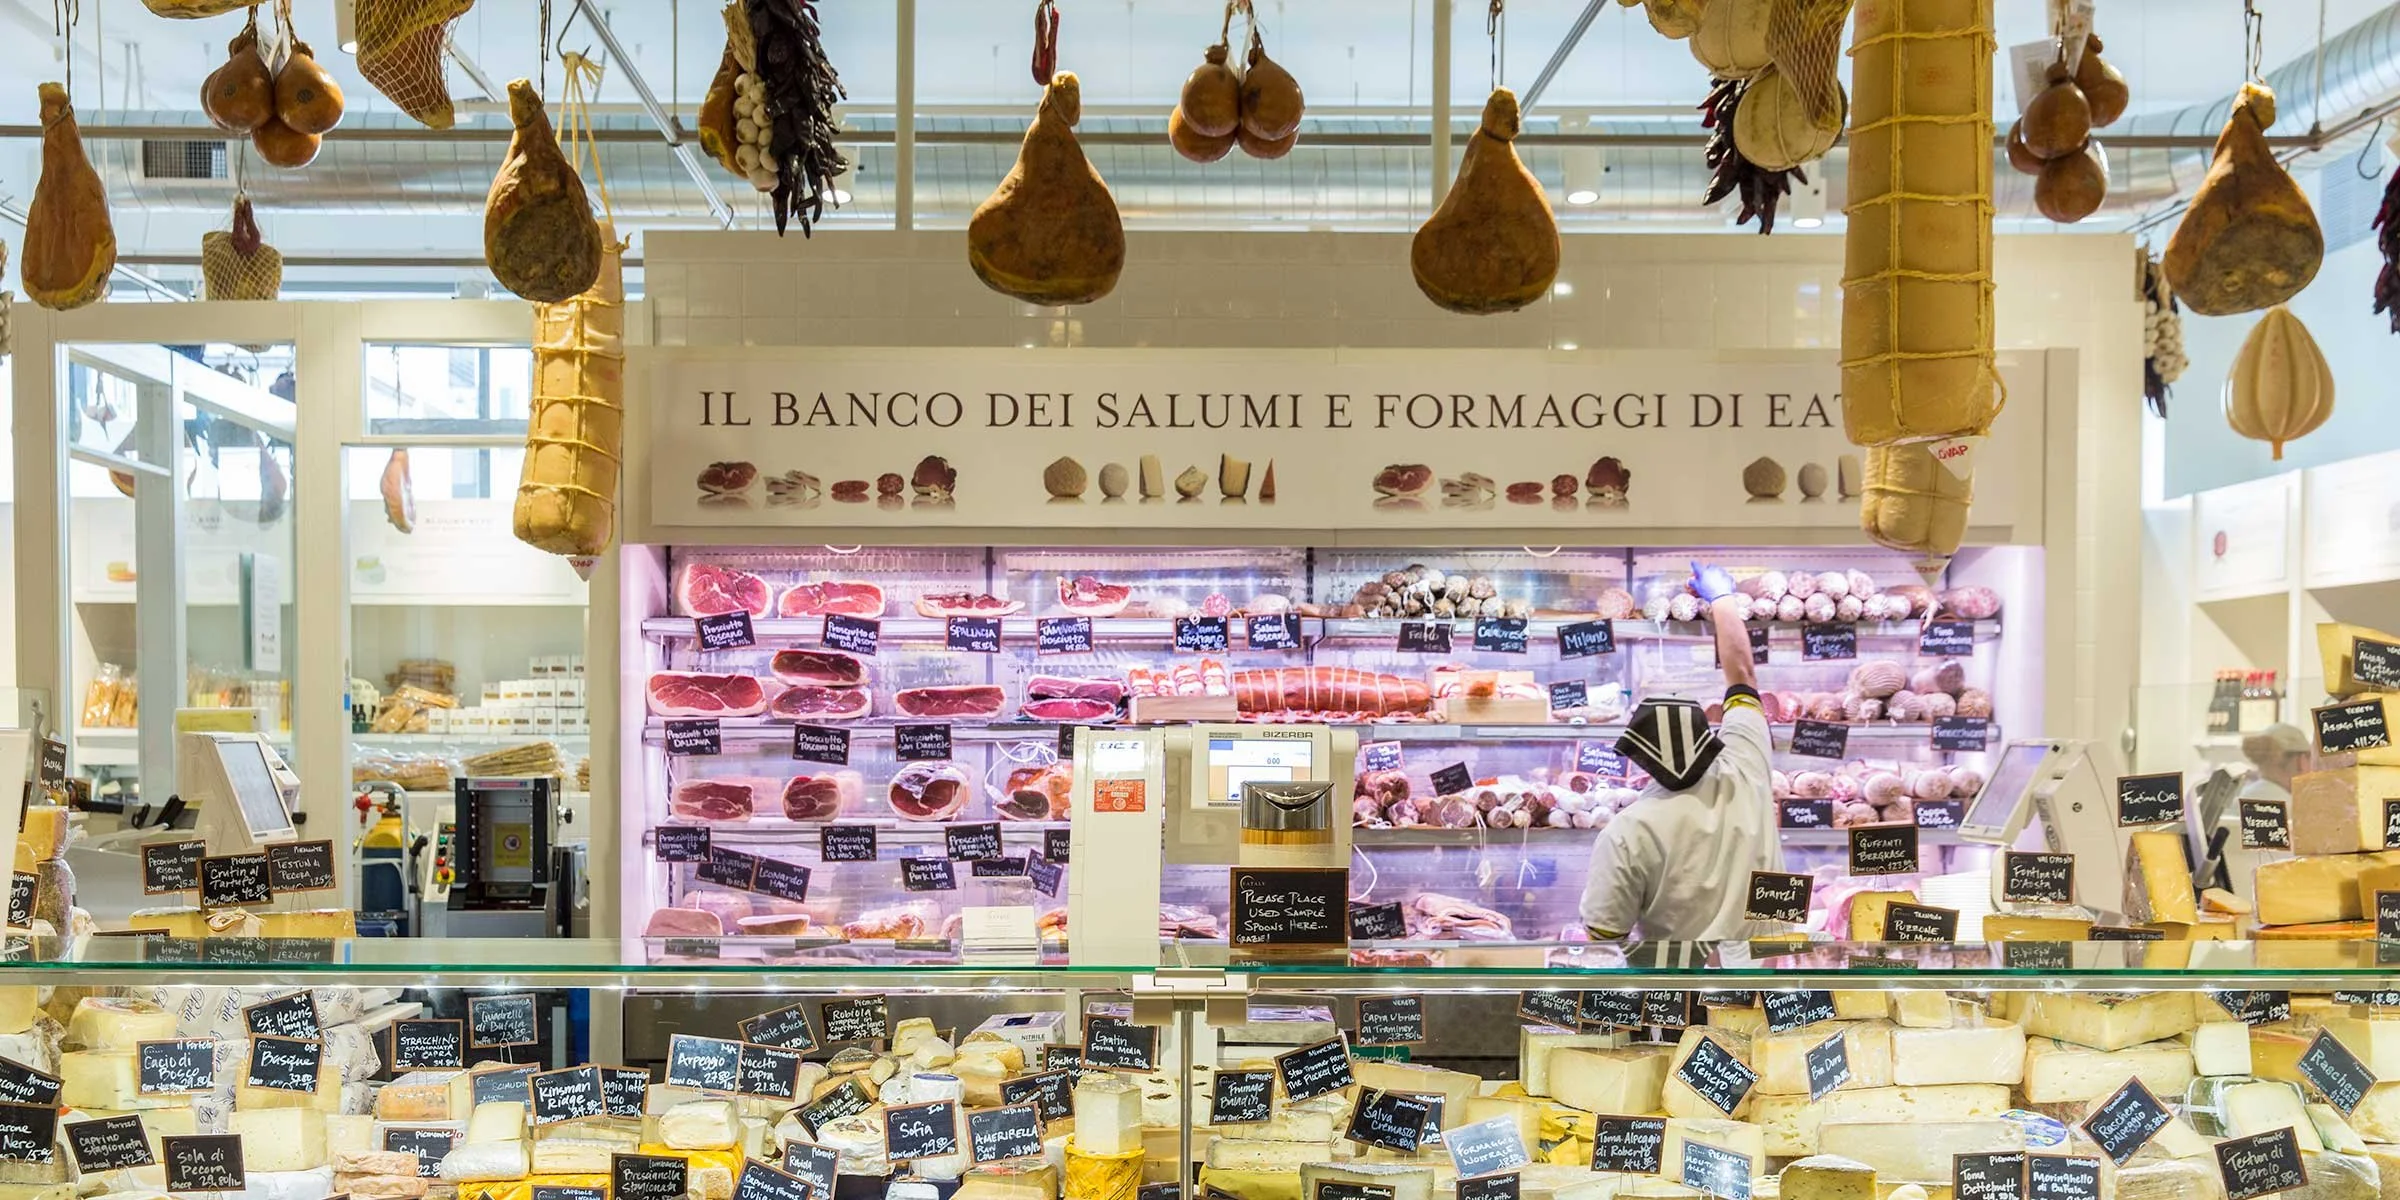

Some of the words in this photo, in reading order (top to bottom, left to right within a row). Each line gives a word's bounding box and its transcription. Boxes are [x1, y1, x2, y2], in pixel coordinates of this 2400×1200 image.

[700, 391, 751, 427] IL
[771, 391, 963, 428] BANCO
[985, 392, 1073, 428] DEI
[1097, 392, 1303, 428] SALUMI
[1324, 393, 1351, 428] E
[1374, 393, 1666, 428] FORMAGGI
[1690, 393, 1742, 428] DI
[1765, 393, 1842, 428] EA
[1263, 731, 1313, 739] BIZERBA
[1241, 889, 1285, 905] PLEASE
[1288, 891, 1326, 905] PLACE
[1249, 908, 1280, 918] USED
[1284, 907, 1326, 918] SAMPLE
[1243, 920, 1283, 932] SPOONS
[1021, 1034, 1046, 1042] NITRILE
[900, 1121, 934, 1139] Sofia
